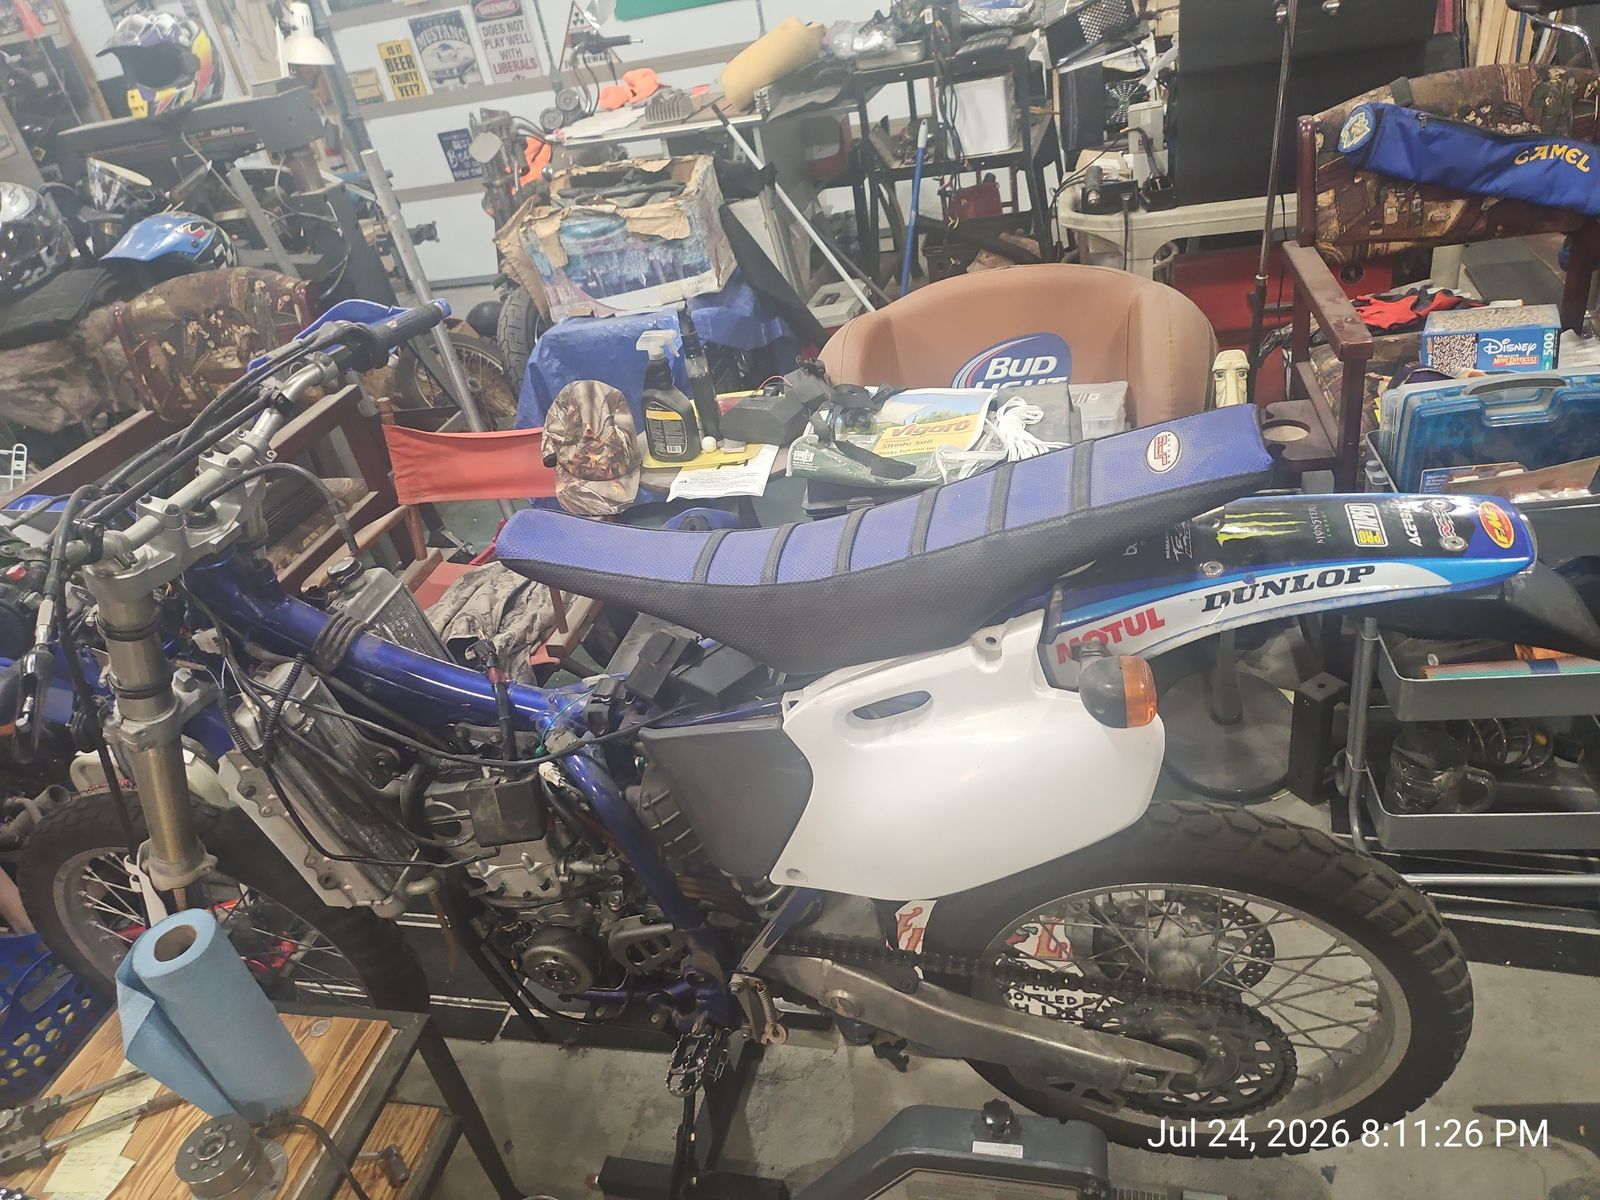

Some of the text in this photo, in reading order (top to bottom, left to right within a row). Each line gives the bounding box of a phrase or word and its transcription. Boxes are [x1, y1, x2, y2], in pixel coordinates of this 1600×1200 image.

[416, 24, 468, 49] MUSTANG
[482, 20, 525, 37] DOES NOT
[386, 44, 403, 55] IS IT
[484, 33, 532, 49] PLAY WELL
[500, 48, 523, 60] WITH
[385, 55, 416, 73] BEER
[493, 57, 537, 75] LIBERALS
[390, 71, 420, 85] THIRTY
[398, 84, 421, 98] YET?
[1514, 144, 1590, 173] CAMEL
[1543, 332, 1554, 356] 500
[985, 355, 1058, 381] BUD
[891, 419, 972, 438] Vigoro
[1307, 505, 1326, 544] MONSTER
[1400, 503, 1423, 547] ACERBI
[1201, 565, 1376, 613] DUNLOP
